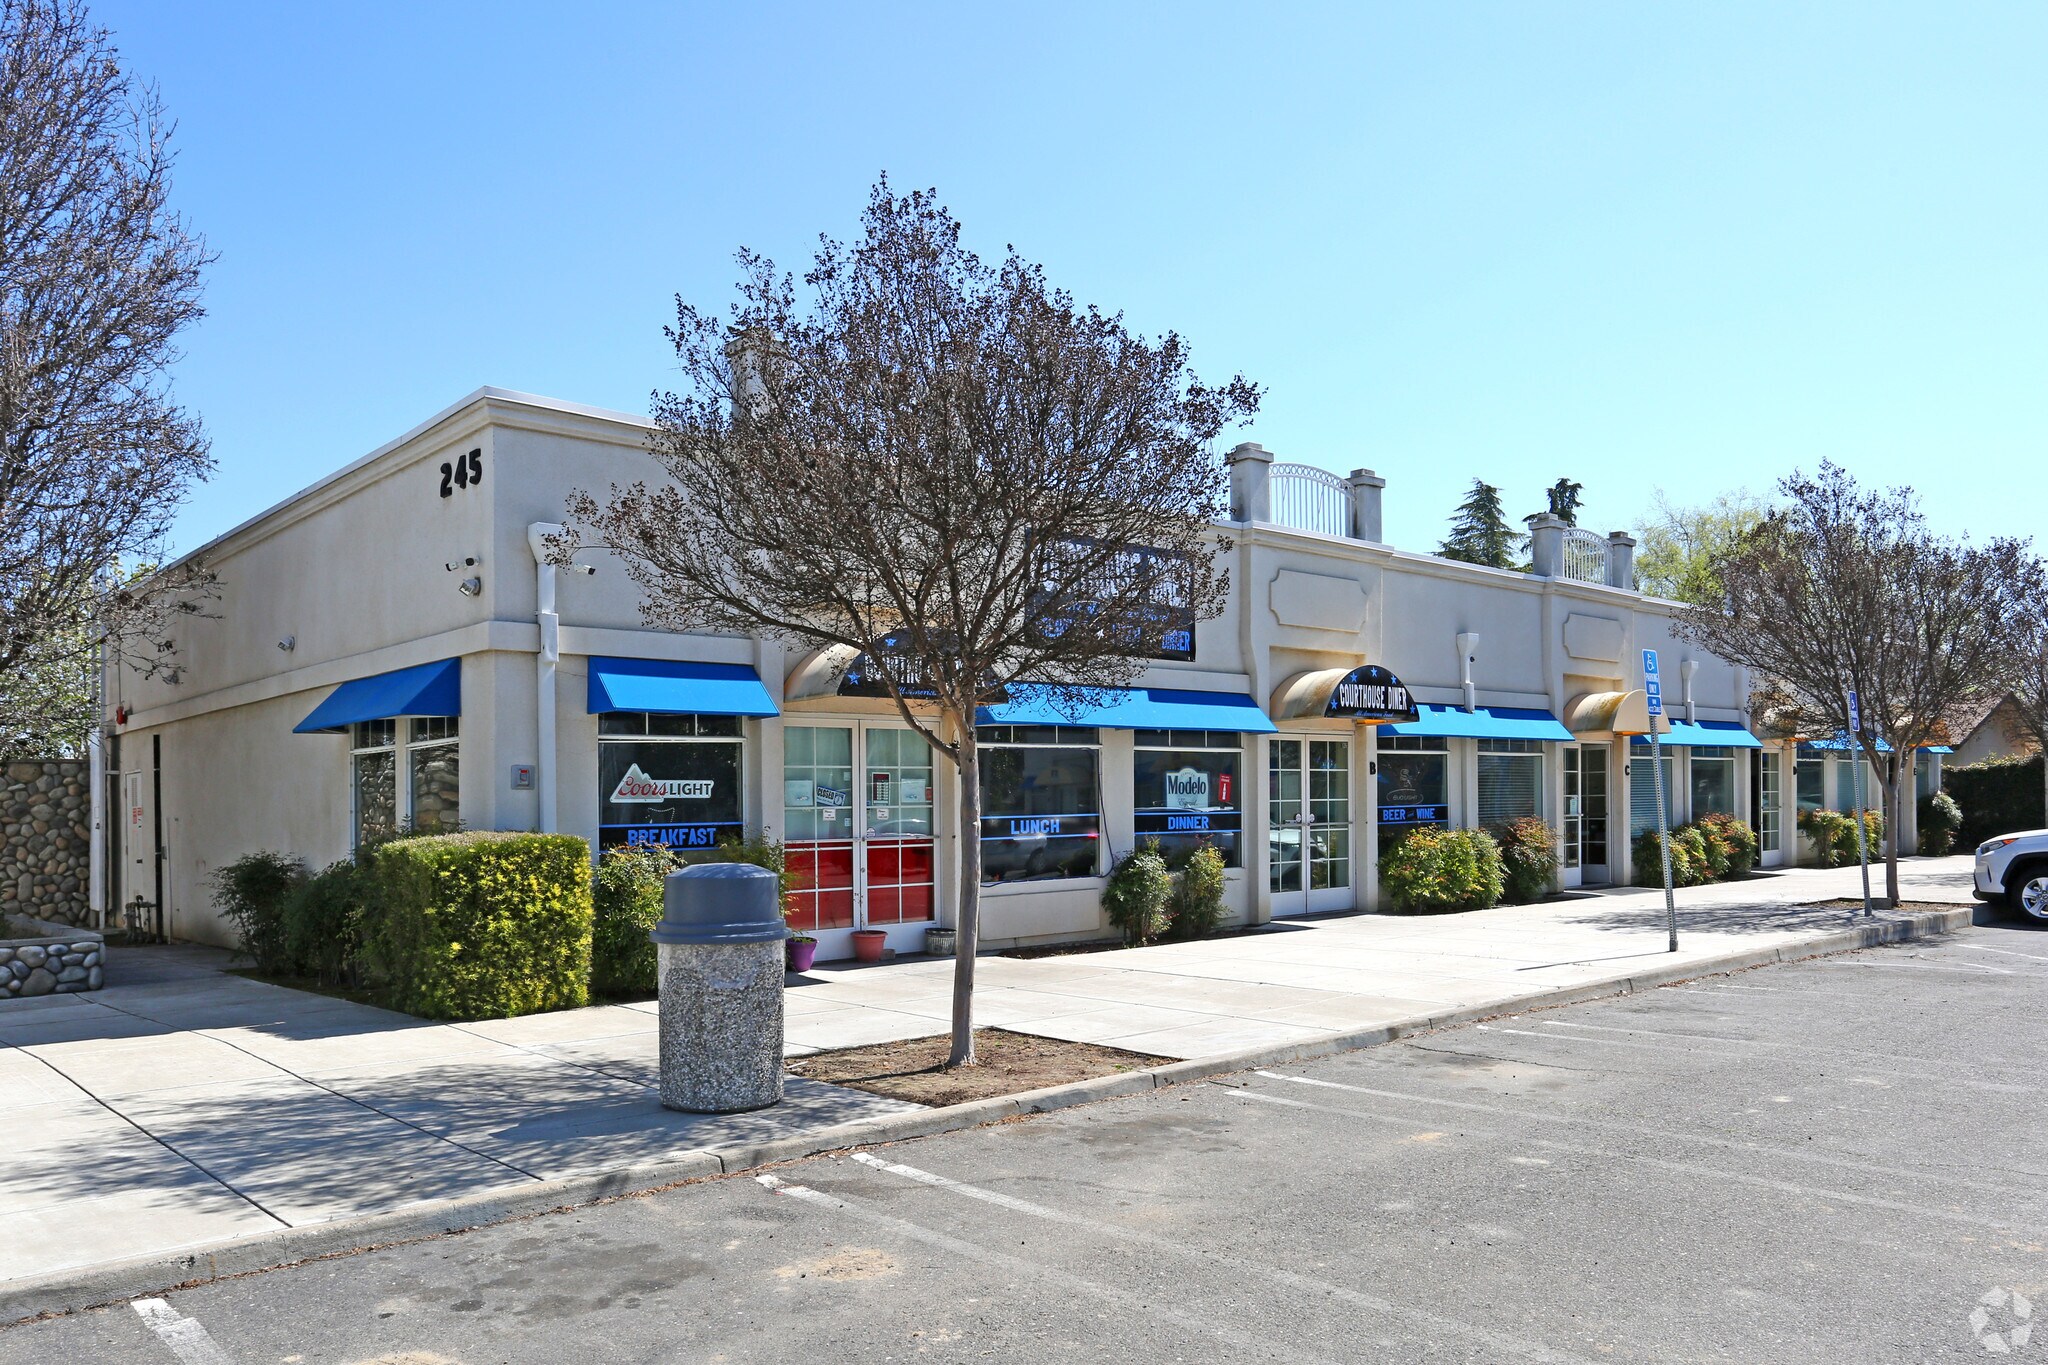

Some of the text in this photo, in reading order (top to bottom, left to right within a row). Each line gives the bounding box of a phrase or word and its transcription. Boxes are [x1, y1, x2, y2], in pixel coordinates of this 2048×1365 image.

[440, 448, 482, 498] 245
[1340, 683, 1408, 711] COURTHOUSE DINER
[1369, 761, 1377, 775] B
[1624, 764, 1630, 776] C
[618, 776, 712, 797] Coors LIGHT
[817, 786, 835, 800] CLOSED
[1167, 775, 1207, 795] Modelo
[1167, 815, 1210, 830] DINNER
[1382, 808, 1406, 821] BEER
[1416, 808, 1436, 819] WINE
[1010, 819, 1060, 835] LUNCH
[627, 827, 717, 847] BREAKFAST
